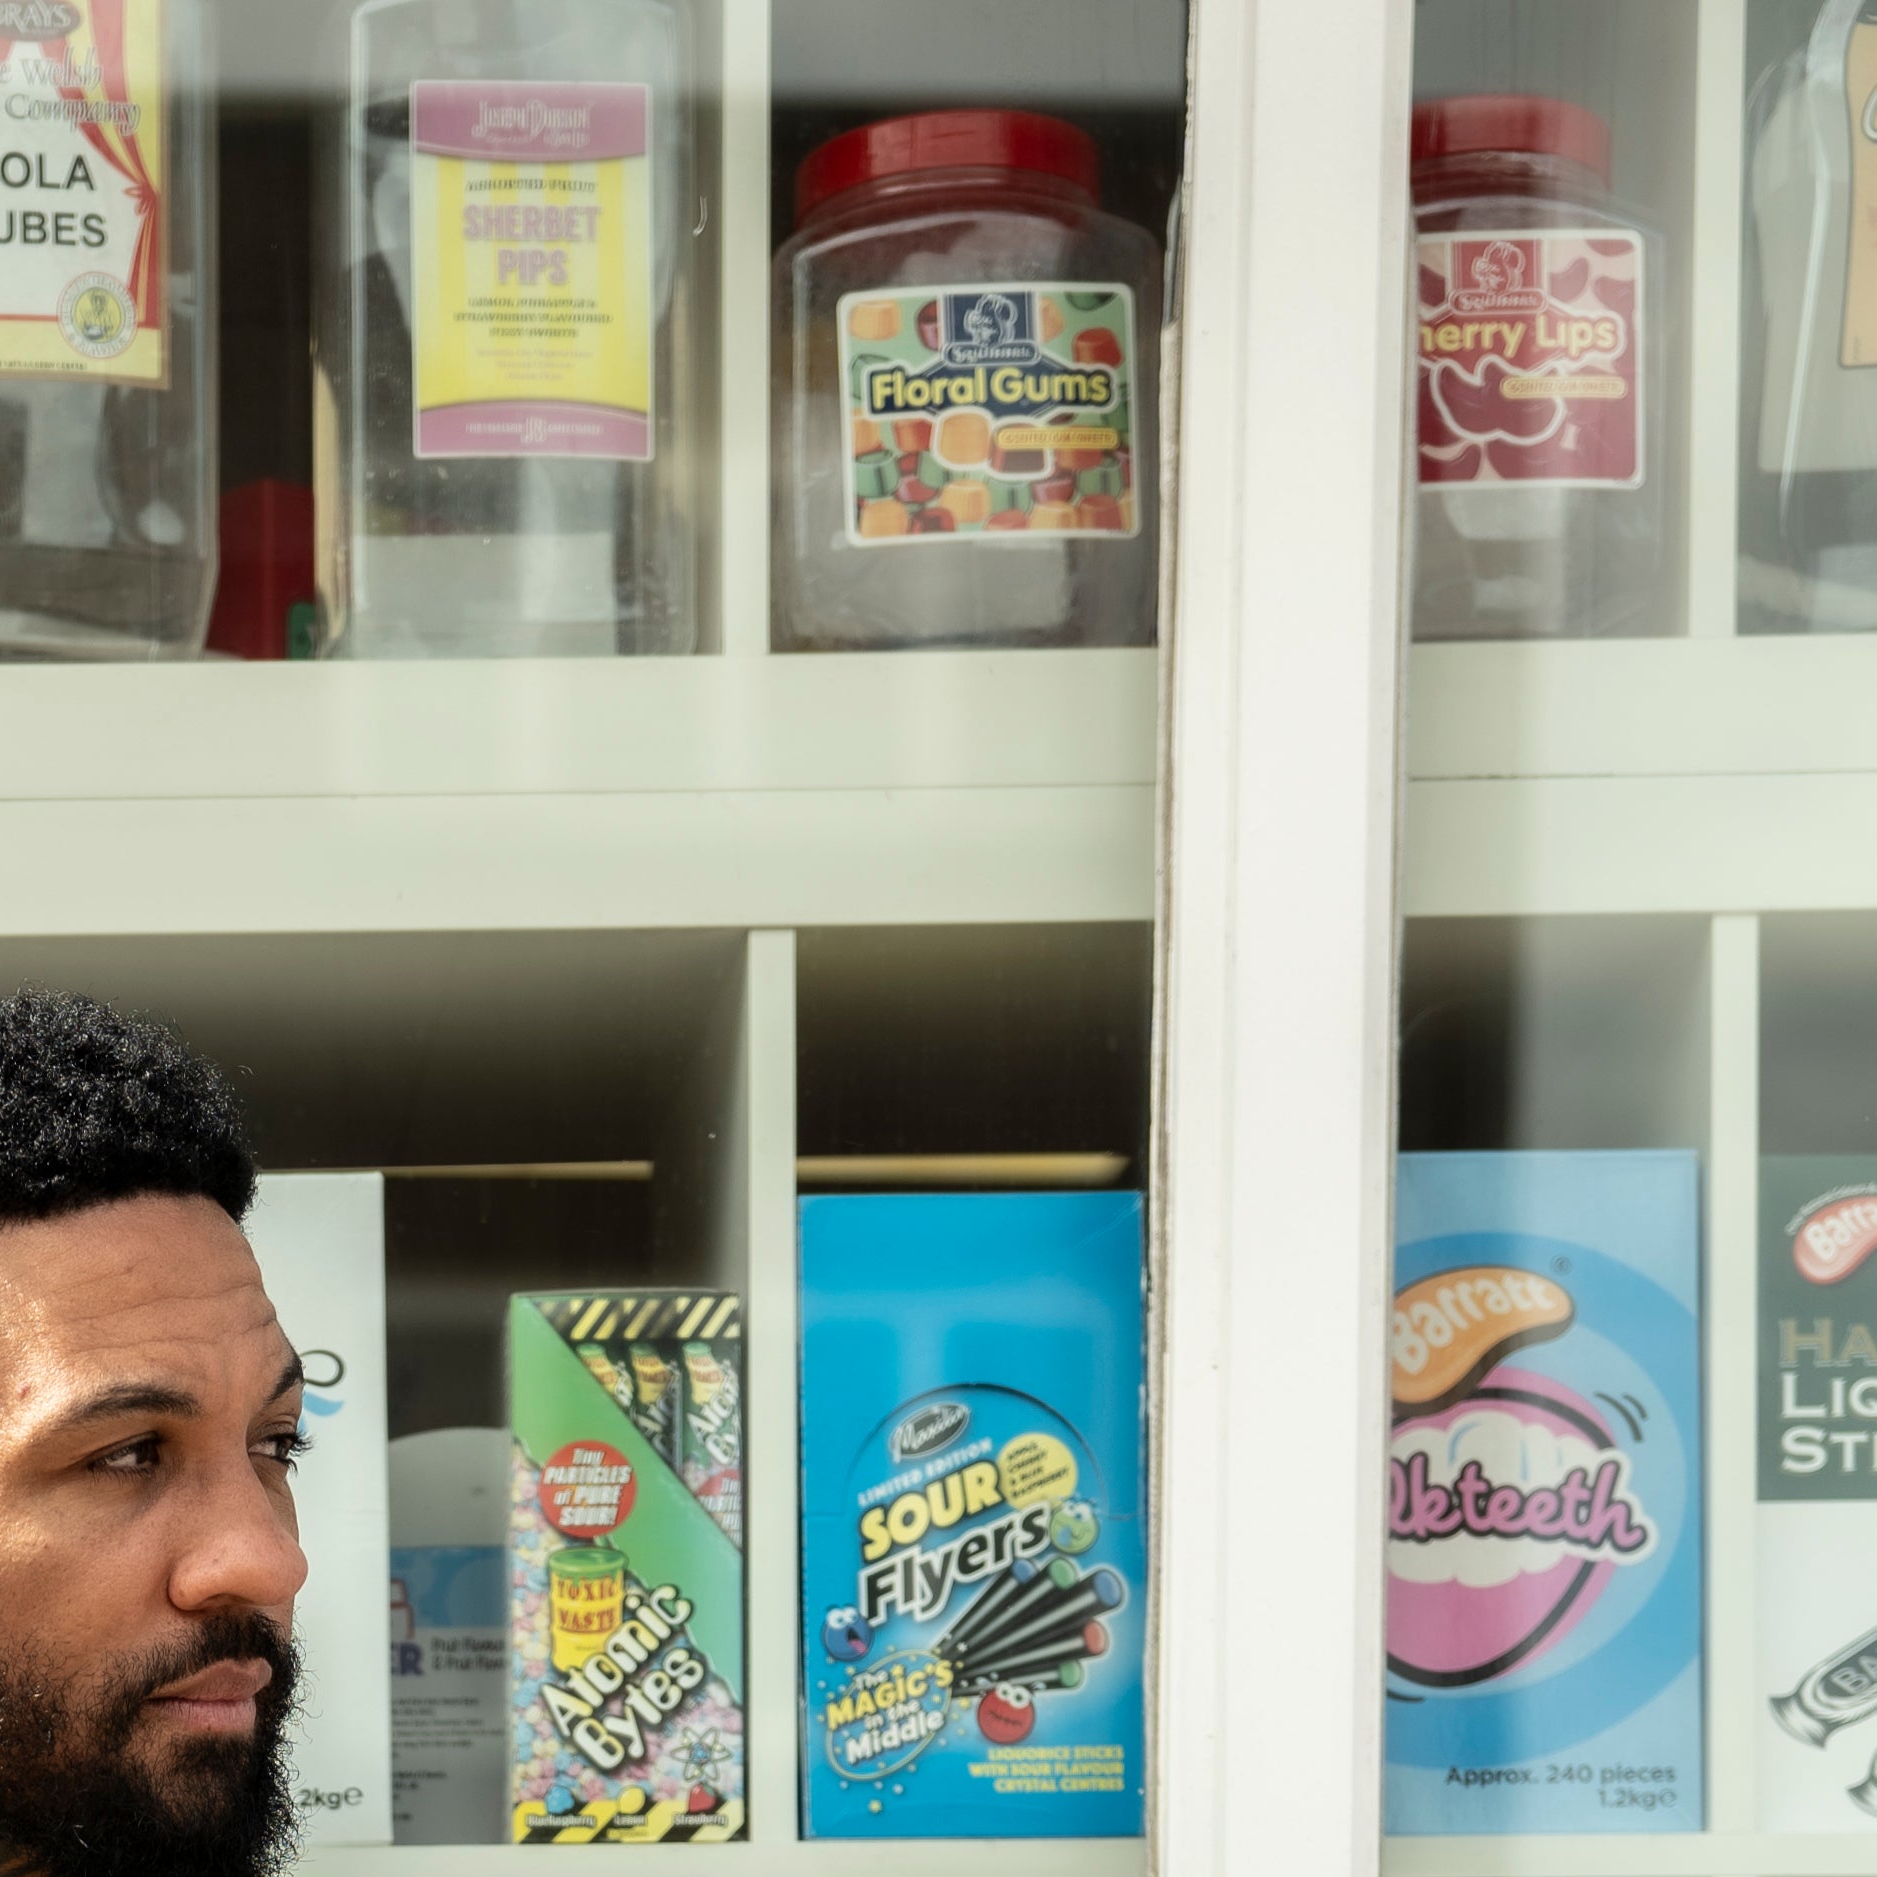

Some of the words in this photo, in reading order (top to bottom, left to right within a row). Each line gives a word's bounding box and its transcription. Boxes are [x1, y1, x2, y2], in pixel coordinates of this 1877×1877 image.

[23, 47, 102, 89] Welsh
[4, 93, 140, 135] Company
[463, 205, 601, 242] SHERBET
[498, 249, 568, 284] PIPS
[1419, 317, 1526, 357] herry
[1536, 311, 1617, 353] Lips
[873, 366, 986, 409] Floral
[992, 368, 1110, 404] Gums
[544, 1465, 632, 1485] PARTICLES
[858, 1469, 923, 1507] LIMITED
[925, 1438, 993, 1478] EDITION
[559, 1506, 617, 1525] SOUR!
[860, 1461, 1002, 1561] SOUR
[861, 1503, 1051, 1624] Flyers
[557, 1577, 617, 1601] TOXIC
[556, 1606, 617, 1630] WASTE
[542, 1584, 692, 1738] Atomic
[854, 1669, 889, 1691] The
[573, 1646, 704, 1770] Bytes
[864, 1713, 884, 1731] in
[886, 1700, 920, 1721] the
[845, 1711, 944, 1765] Middle
[987, 1746, 1070, 1761] LIQUORICE
[1073, 1745, 1125, 1760] STICKS
[969, 1763, 1009, 1777] WITH
[1011, 1763, 1051, 1777] SOUR
[1054, 1762, 1125, 1776] FLAVOUR
[994, 1779, 1057, 1793] CRYSTAL
[1059, 1778, 1125, 1792] CENTRES
[1446, 1765, 1540, 1787] Approx.
[1546, 1765, 1593, 1785] 240
[1599, 1764, 1677, 1788] pieces
